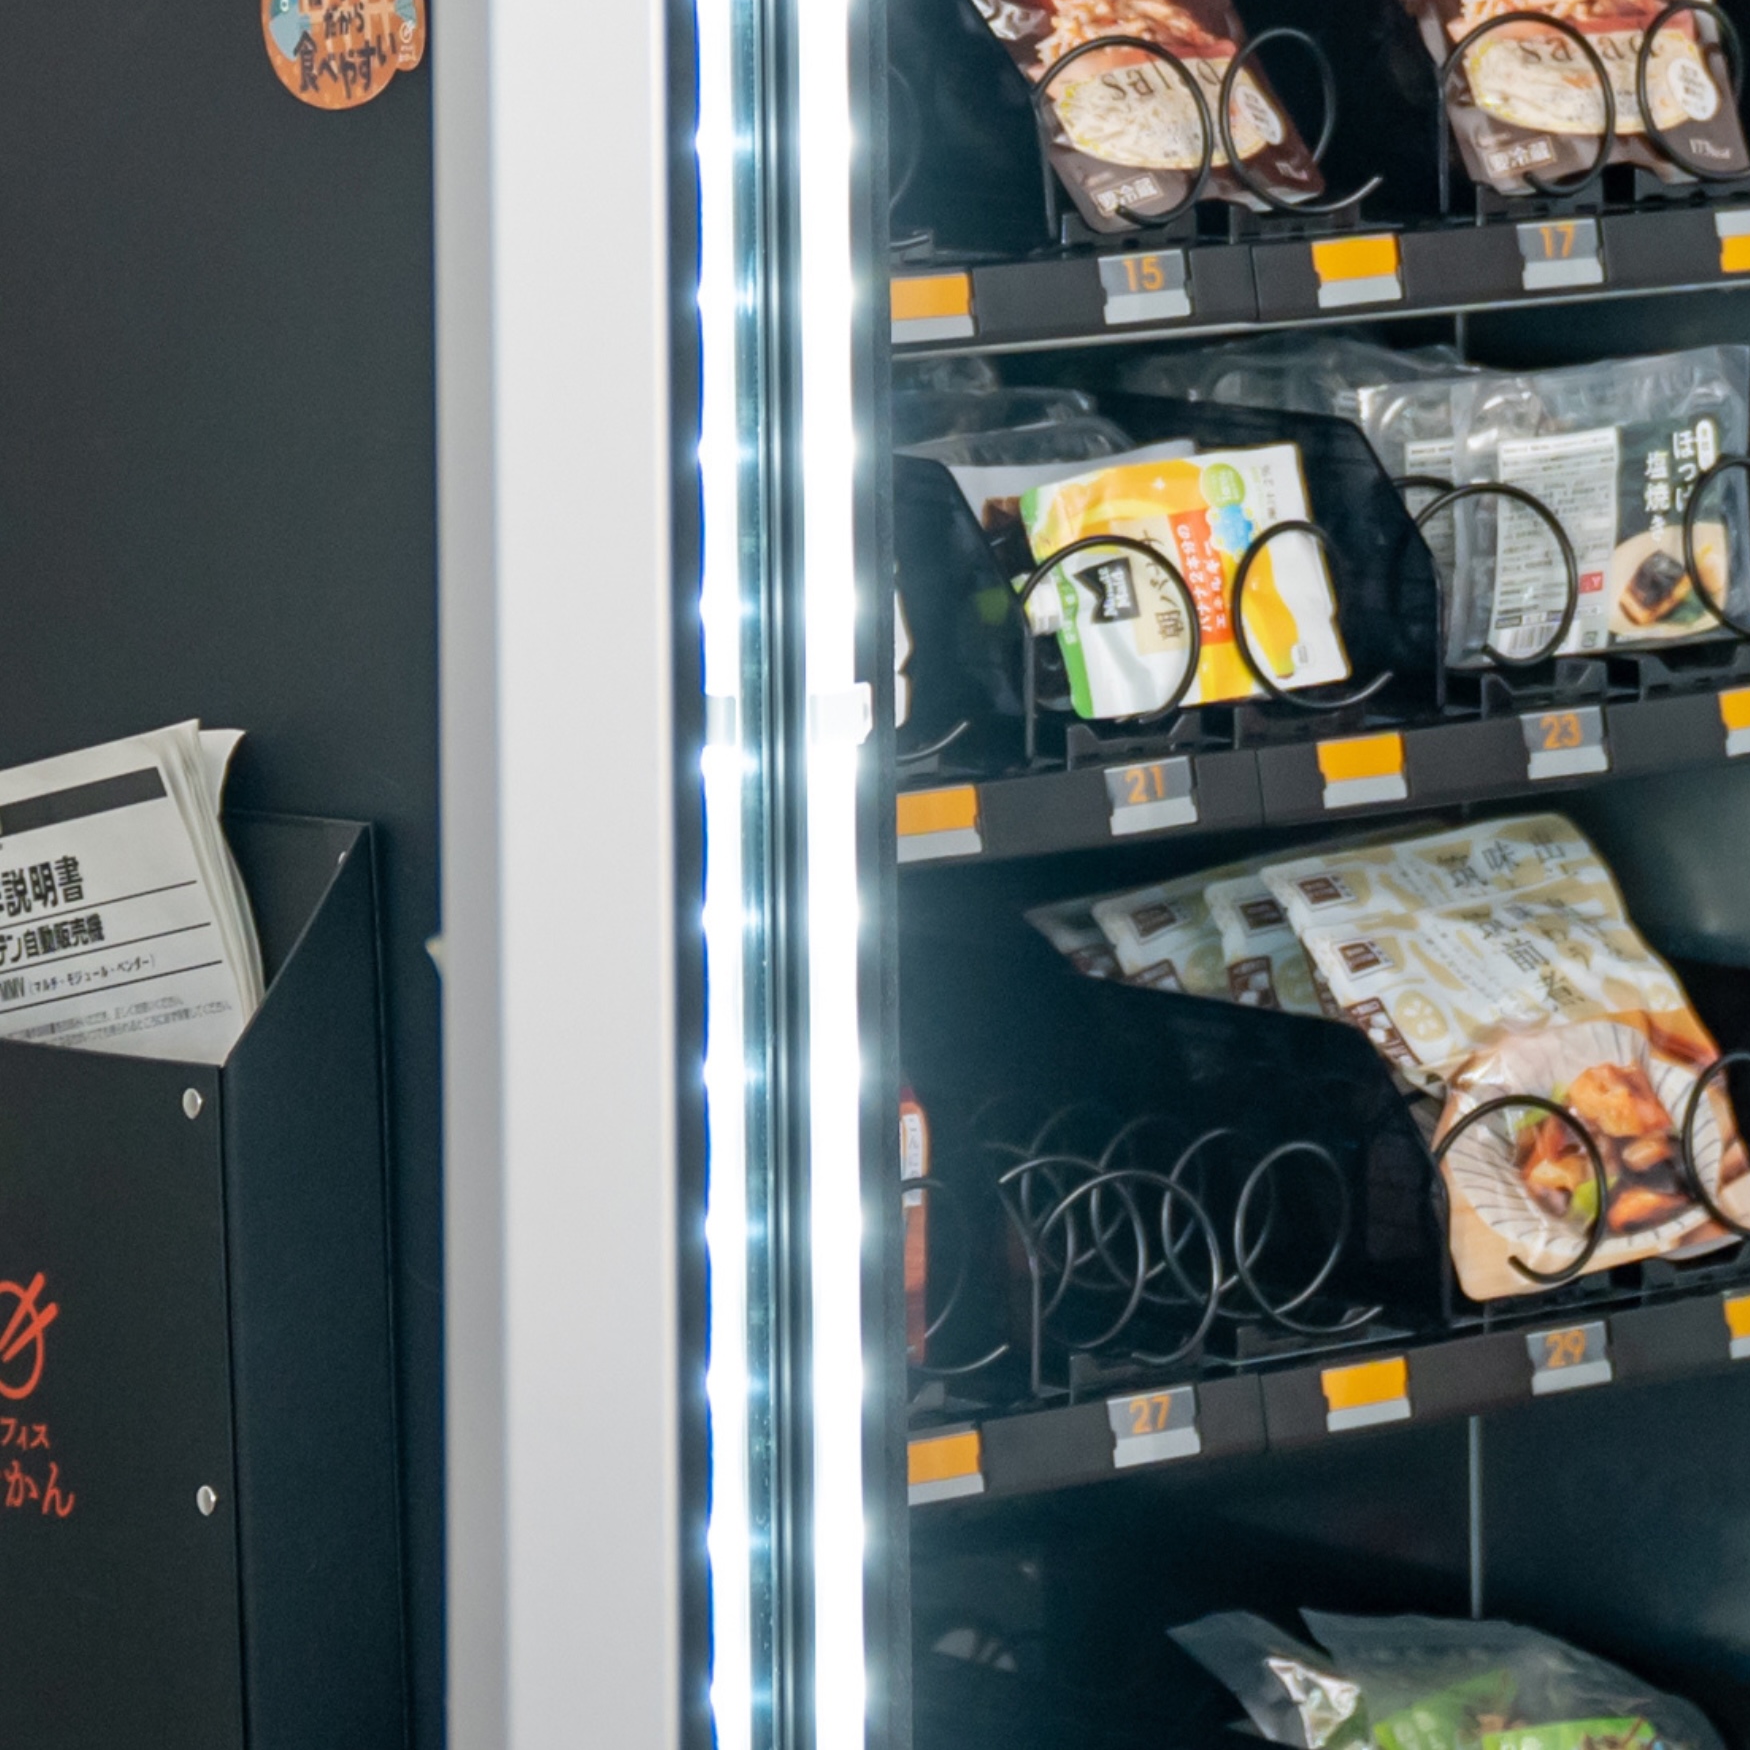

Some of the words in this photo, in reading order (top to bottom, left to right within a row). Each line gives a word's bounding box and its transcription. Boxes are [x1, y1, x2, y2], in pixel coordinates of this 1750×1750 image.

[322, 1, 366, 39] だから
[292, 22, 397, 100] 食べやすい
[1540, 223, 1576, 258] 17
[1123, 256, 1165, 292] 15
[1110, 566, 1131, 609] Maid
[1540, 713, 1582, 750] 23
[1125, 765, 1165, 803] 21
[0, 855, 84, 918] 説明書
[1546, 1328, 1586, 1367] 29
[1130, 1394, 1171, 1433] 27
